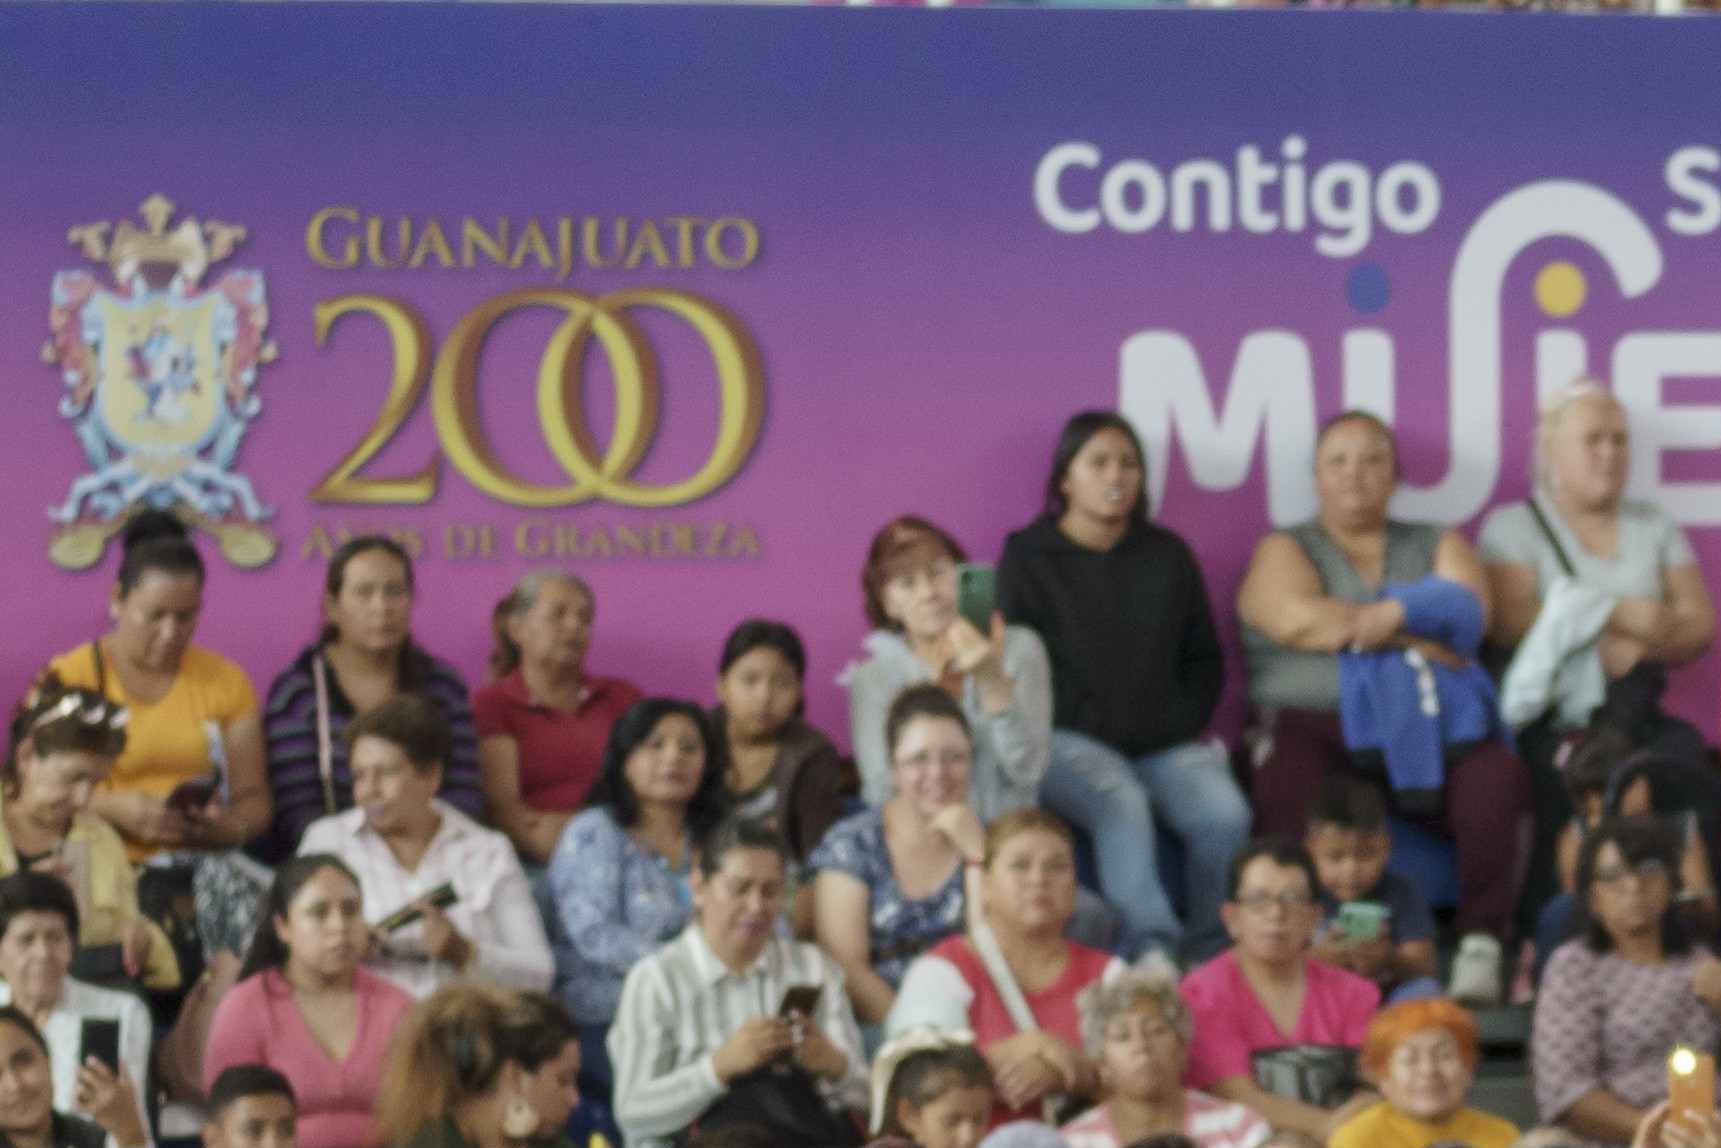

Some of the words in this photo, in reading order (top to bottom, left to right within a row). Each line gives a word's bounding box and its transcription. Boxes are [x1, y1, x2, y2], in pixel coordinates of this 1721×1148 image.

[304, 206, 761, 282] GUANAJUATO
[1033, 134, 1442, 258] Contigo
[306, 285, 767, 508] 200
[514, 516, 764, 558] GRANDEZA
